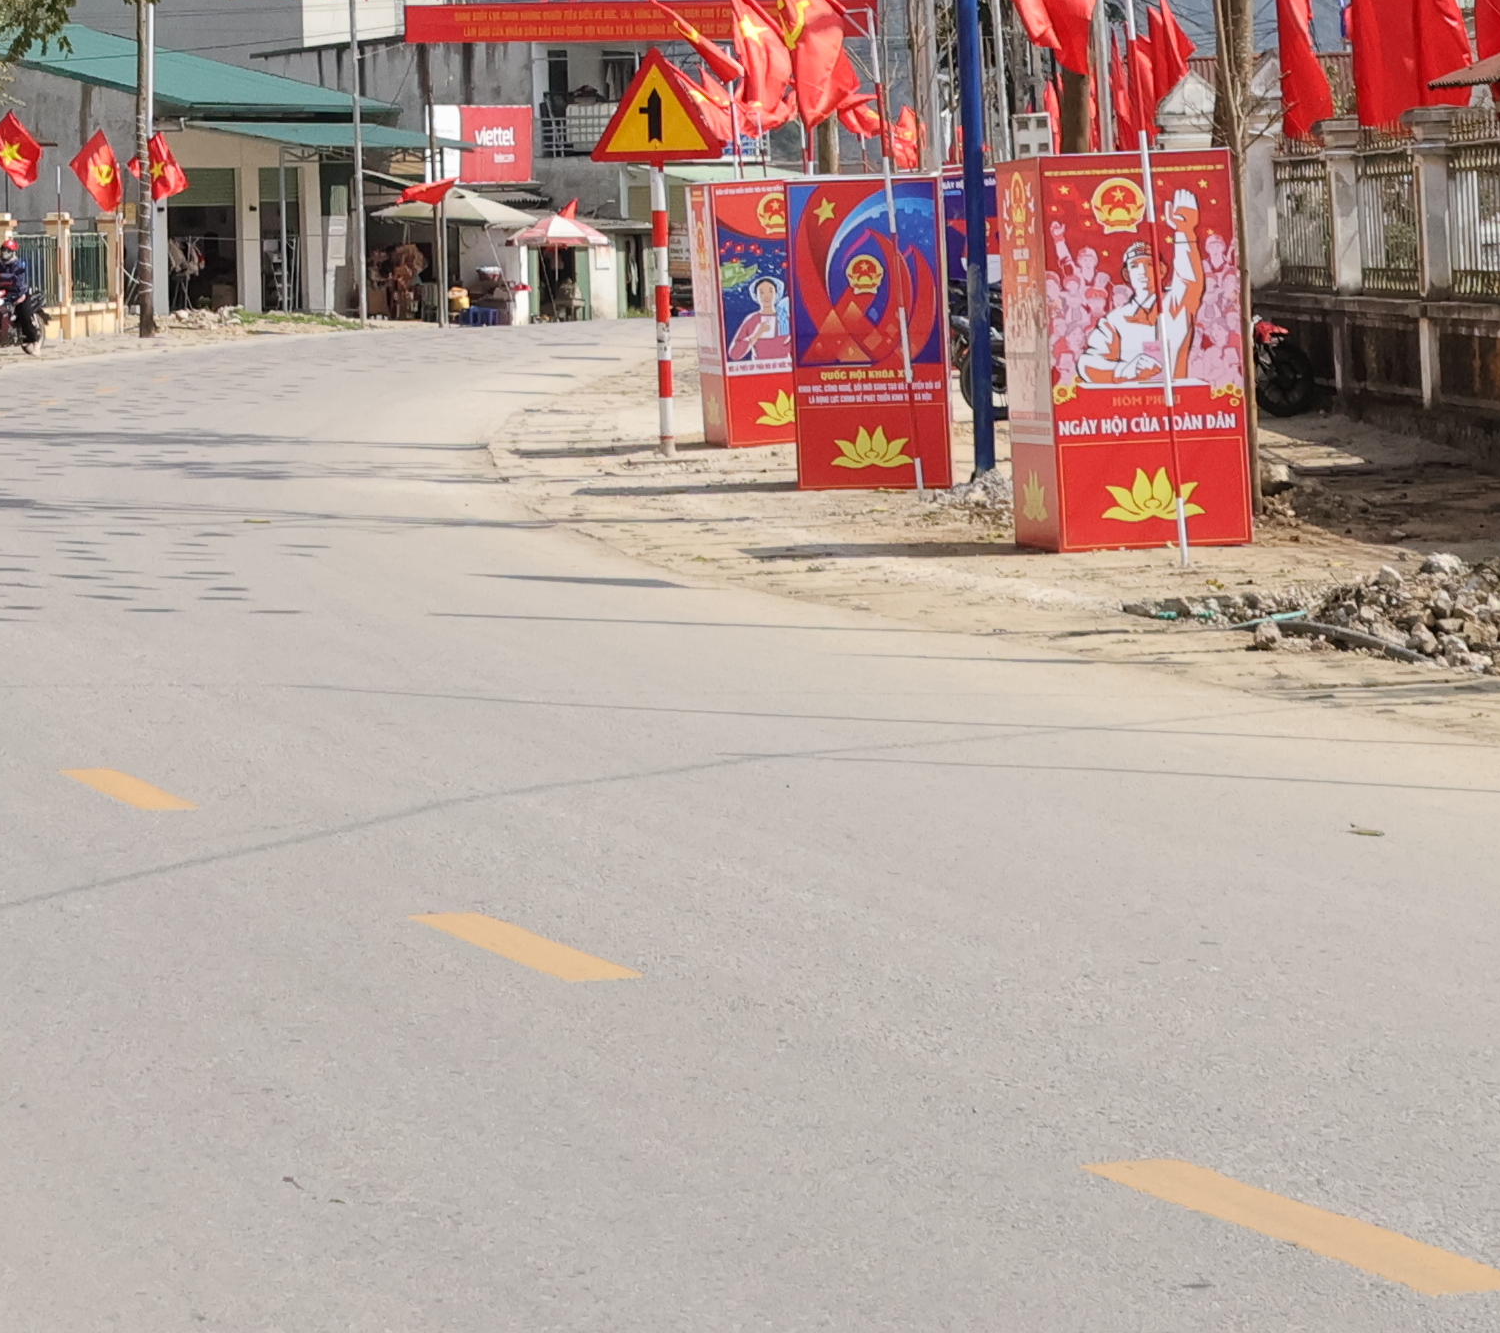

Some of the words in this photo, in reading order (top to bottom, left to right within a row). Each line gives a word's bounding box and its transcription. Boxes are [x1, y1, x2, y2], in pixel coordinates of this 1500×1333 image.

[475, 126, 515, 146] viettel
[821, 369, 847, 381] QUỐC
[850, 370, 866, 381] HỘI
[869, 369, 895, 379] KHÓA
[1058, 417, 1098, 436] NGÀY
[1102, 415, 1127, 436] HỘI
[1131, 412, 1160, 432] CỦA
[1206, 411, 1236, 429] DÂN
